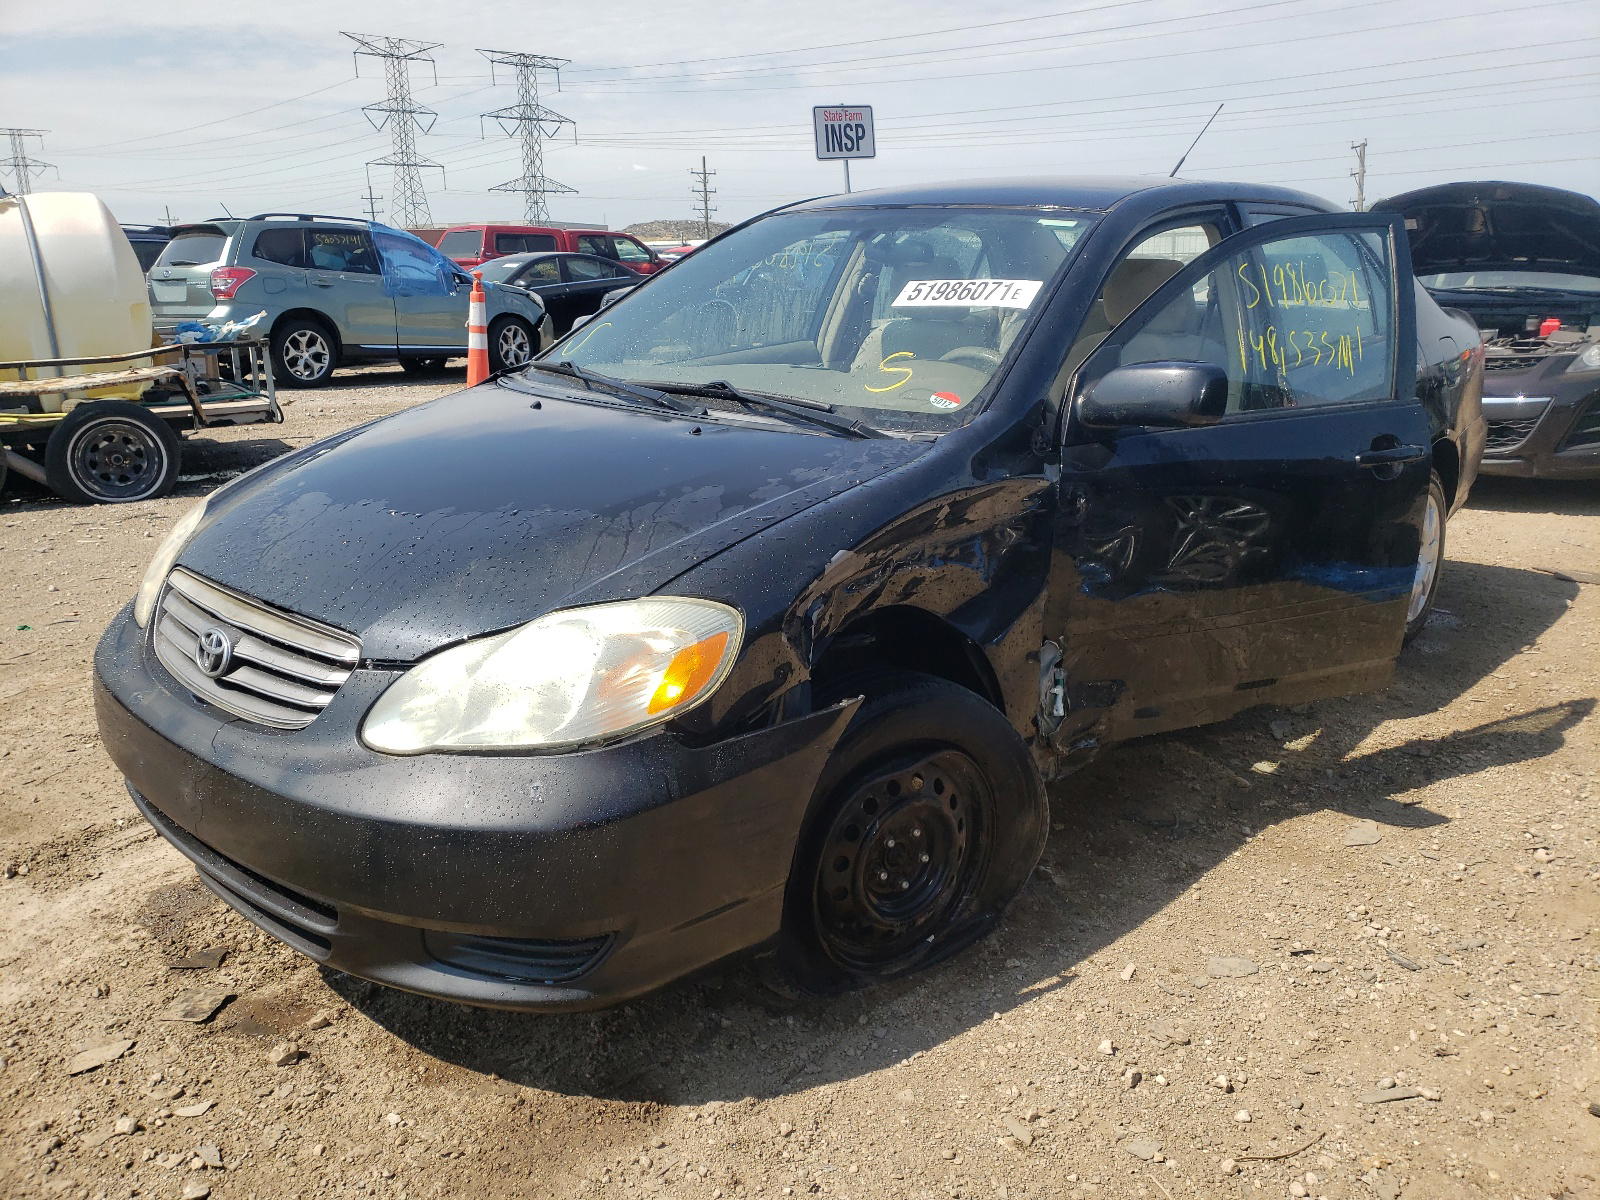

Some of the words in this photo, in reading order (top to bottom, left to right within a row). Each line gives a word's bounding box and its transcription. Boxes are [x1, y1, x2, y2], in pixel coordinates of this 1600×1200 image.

[824, 110, 842, 122] State
[844, 110, 863, 121] Farm
[825, 123, 866, 152] INSP
